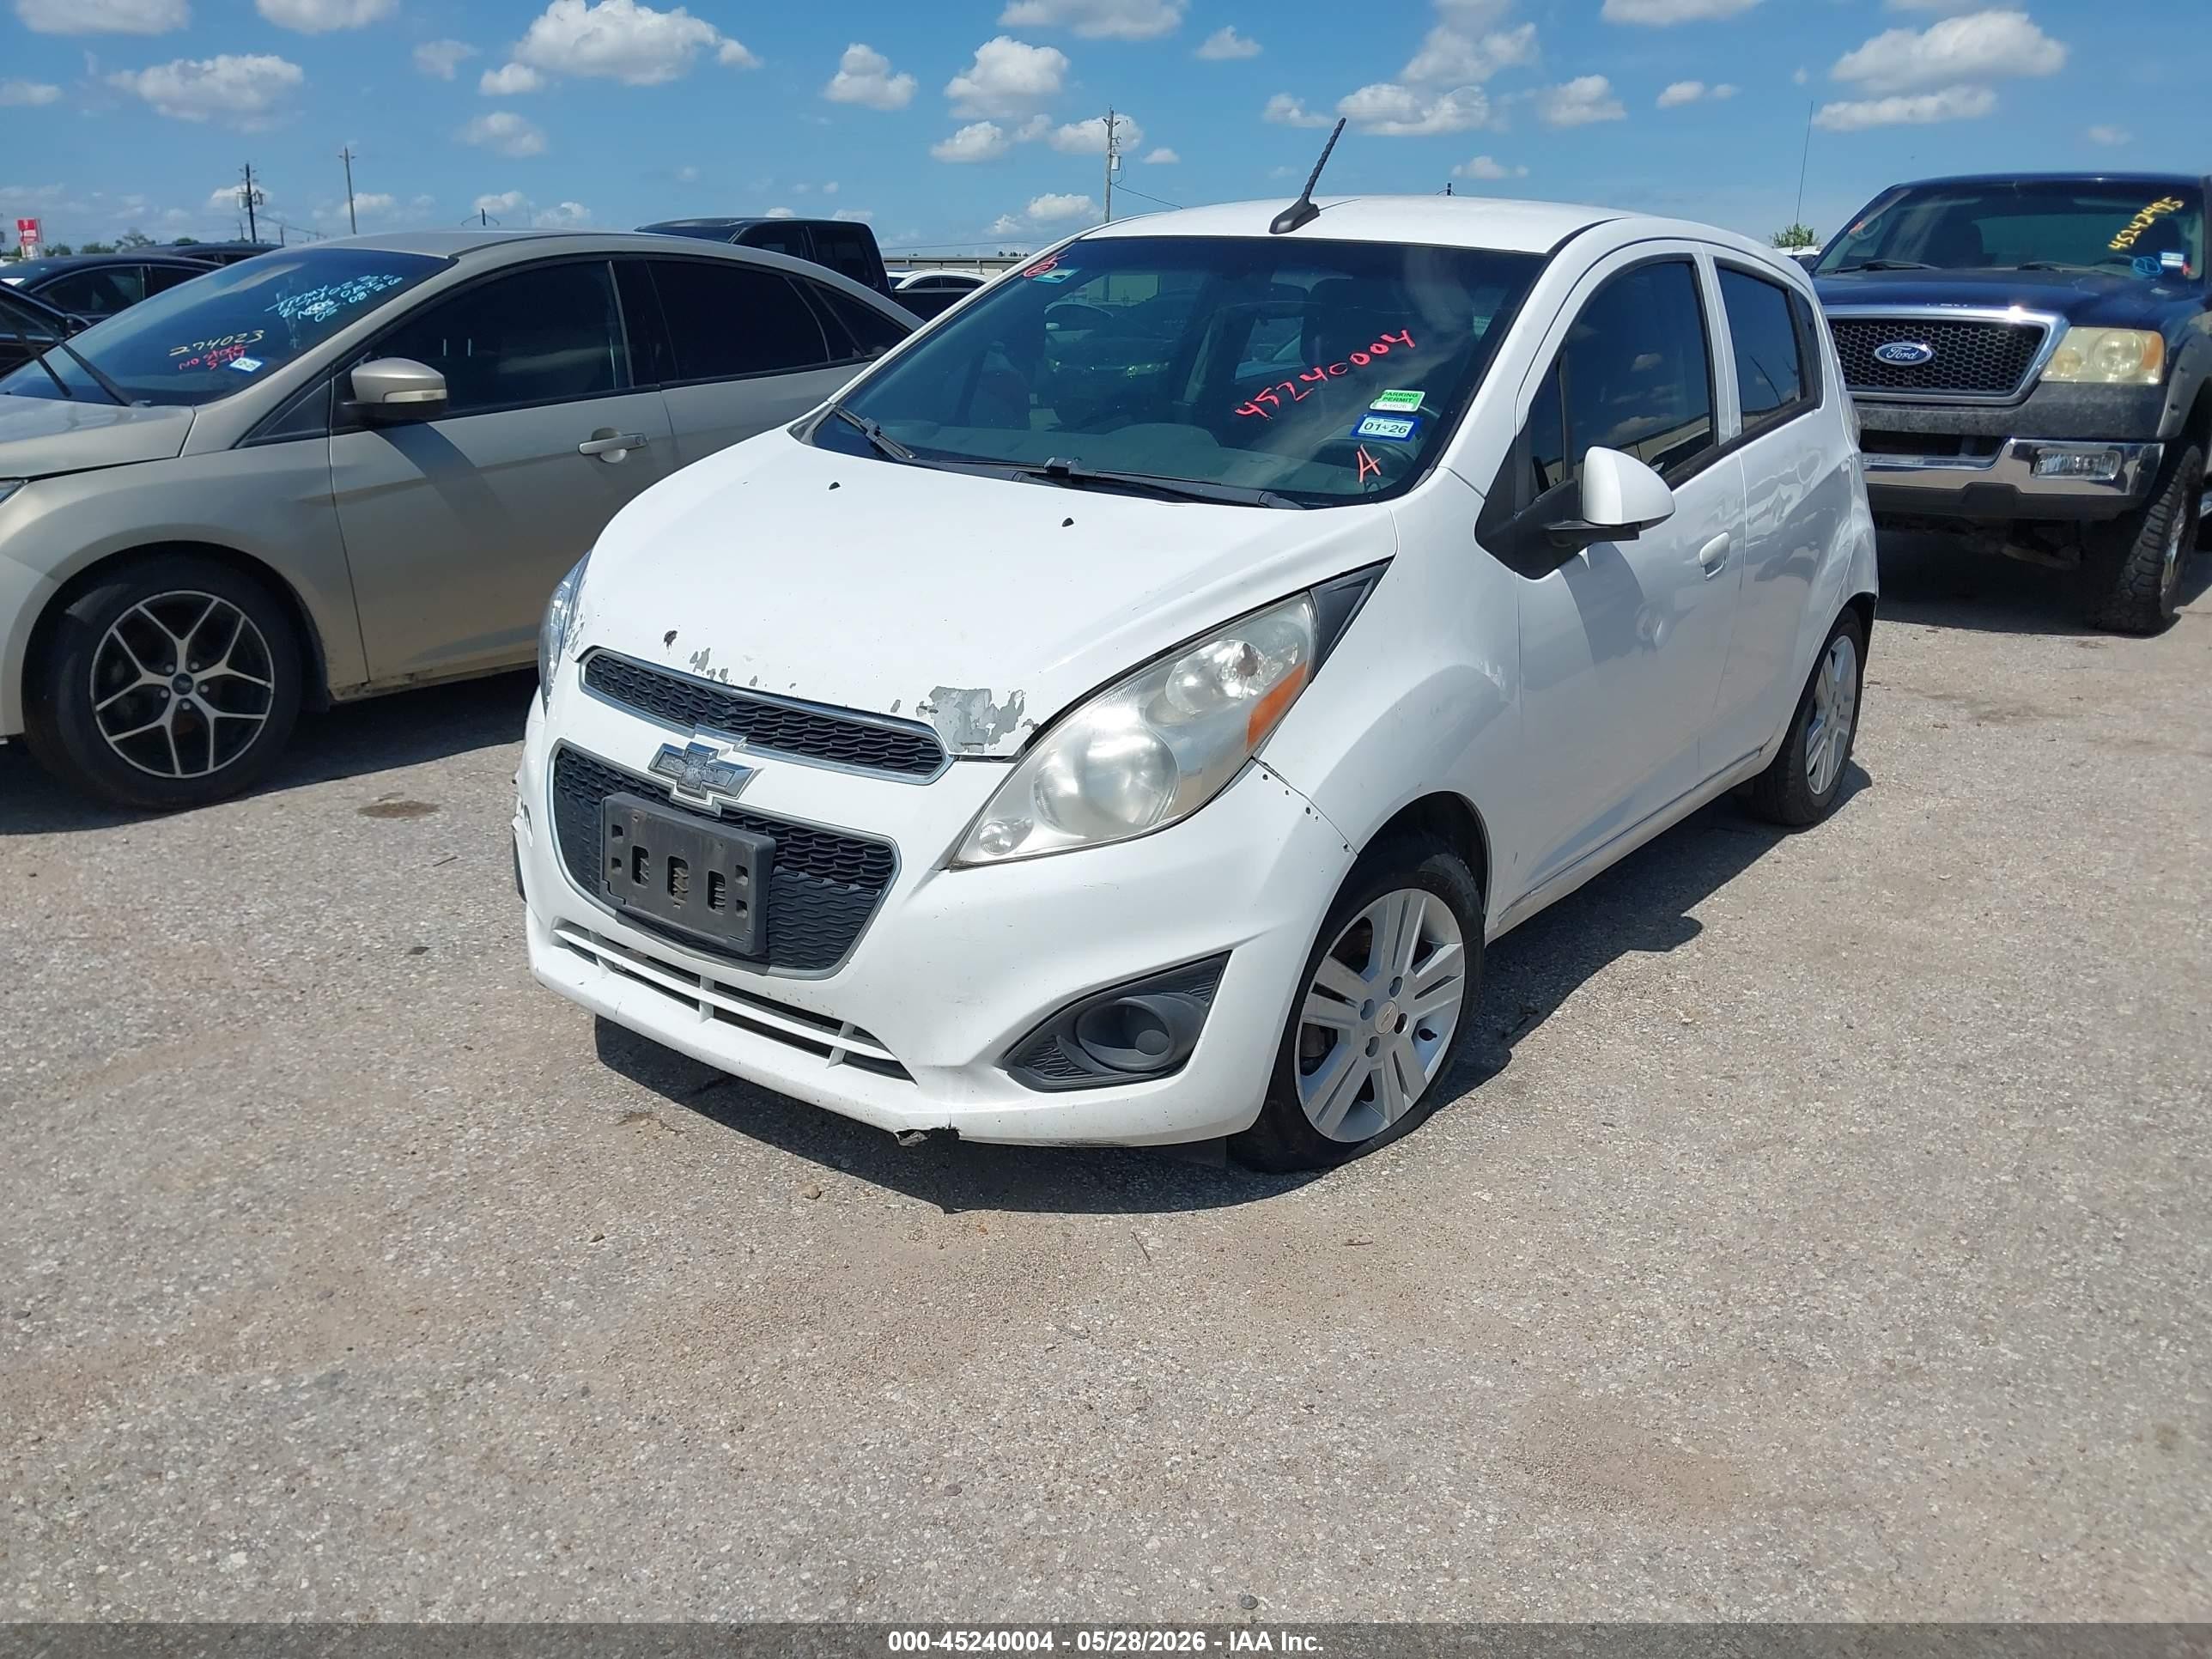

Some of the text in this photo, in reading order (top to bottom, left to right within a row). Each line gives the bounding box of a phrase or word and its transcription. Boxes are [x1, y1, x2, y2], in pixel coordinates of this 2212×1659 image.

[168, 329, 264, 357] 274023
[1886, 346, 1920, 360] Ford
[1356, 443, 1382, 483] A
